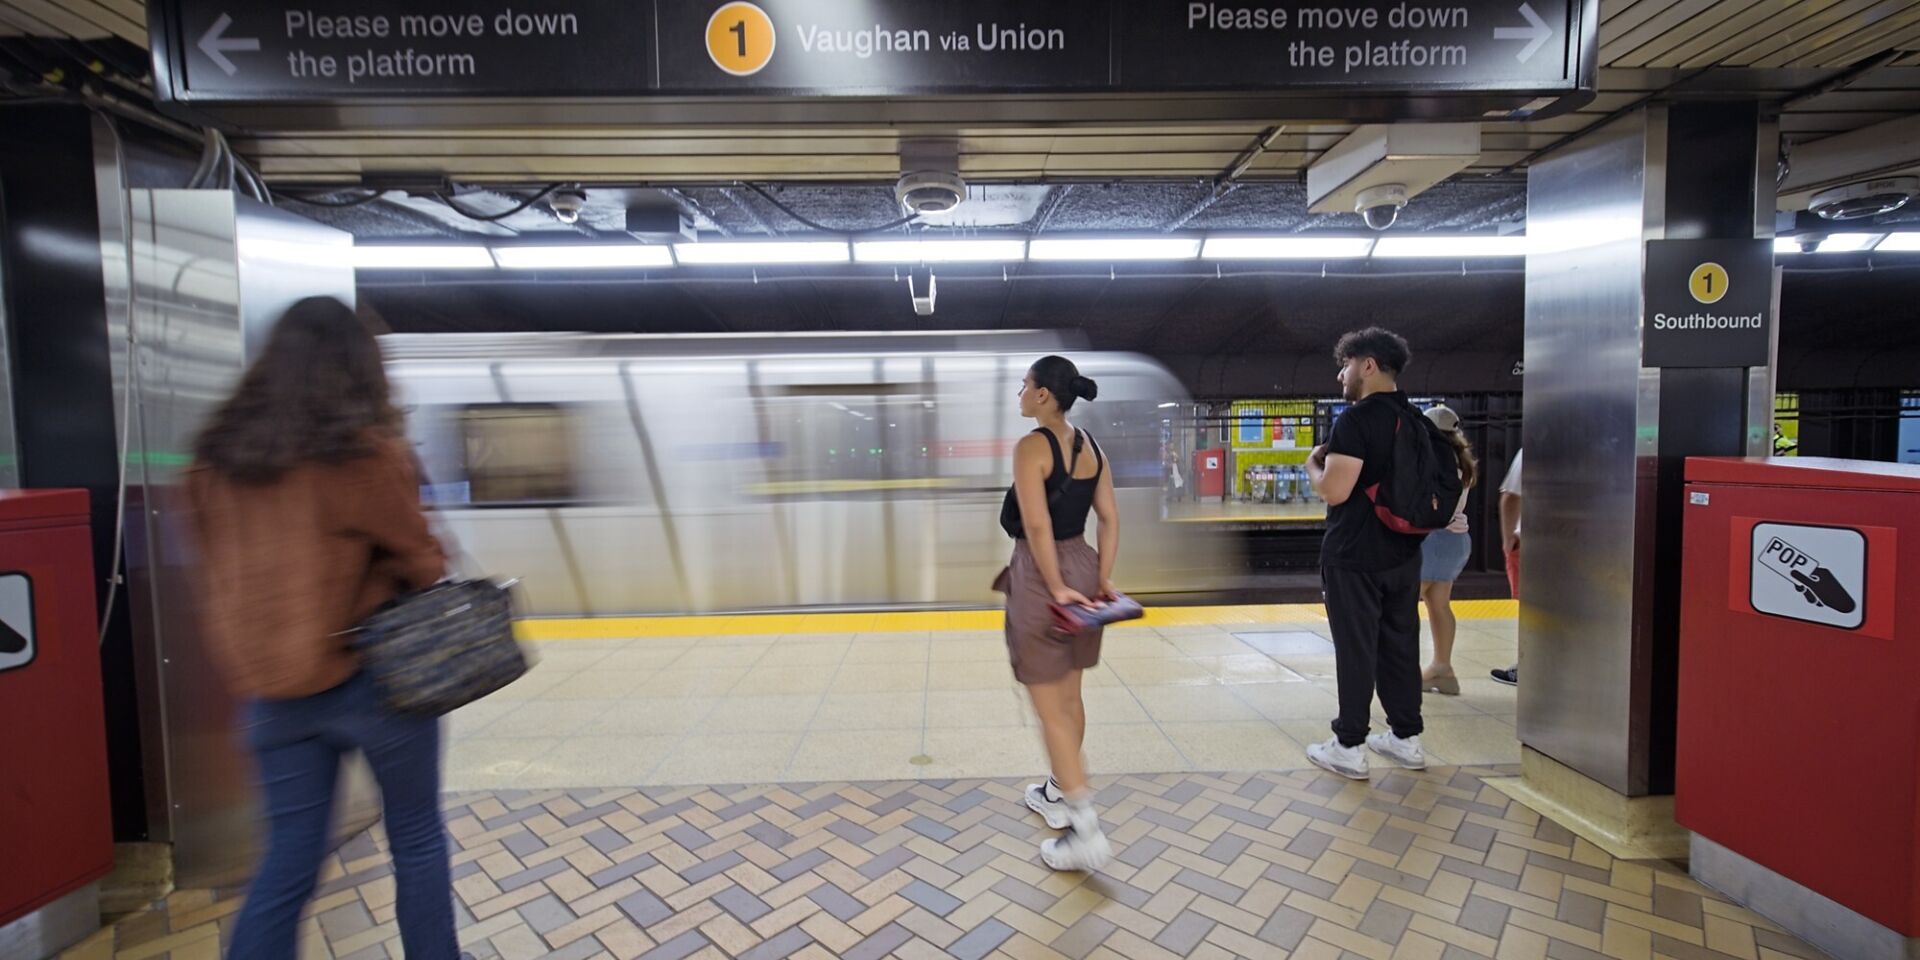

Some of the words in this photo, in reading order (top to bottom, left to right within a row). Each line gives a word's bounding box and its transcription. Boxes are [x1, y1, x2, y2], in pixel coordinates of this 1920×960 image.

[285, 10, 390, 38] Please
[401, 14, 484, 36] move
[494, 9, 578, 36] down
[1188, 2, 1287, 29] Please
[1298, 7, 1378, 29] move
[1388, 2, 1468, 28] down
[729, 20, 746, 57] 1
[797, 24, 930, 58] Vaughan
[940, 31, 970, 50] via
[977, 23, 1065, 50] Union
[288, 50, 337, 77] the
[348, 48, 475, 83] platform
[1288, 40, 1335, 67] the
[1345, 40, 1467, 73] platform
[1703, 272, 1712, 293] 1
[1654, 312, 1762, 329] Southbound
[1766, 540, 1808, 568] POP
